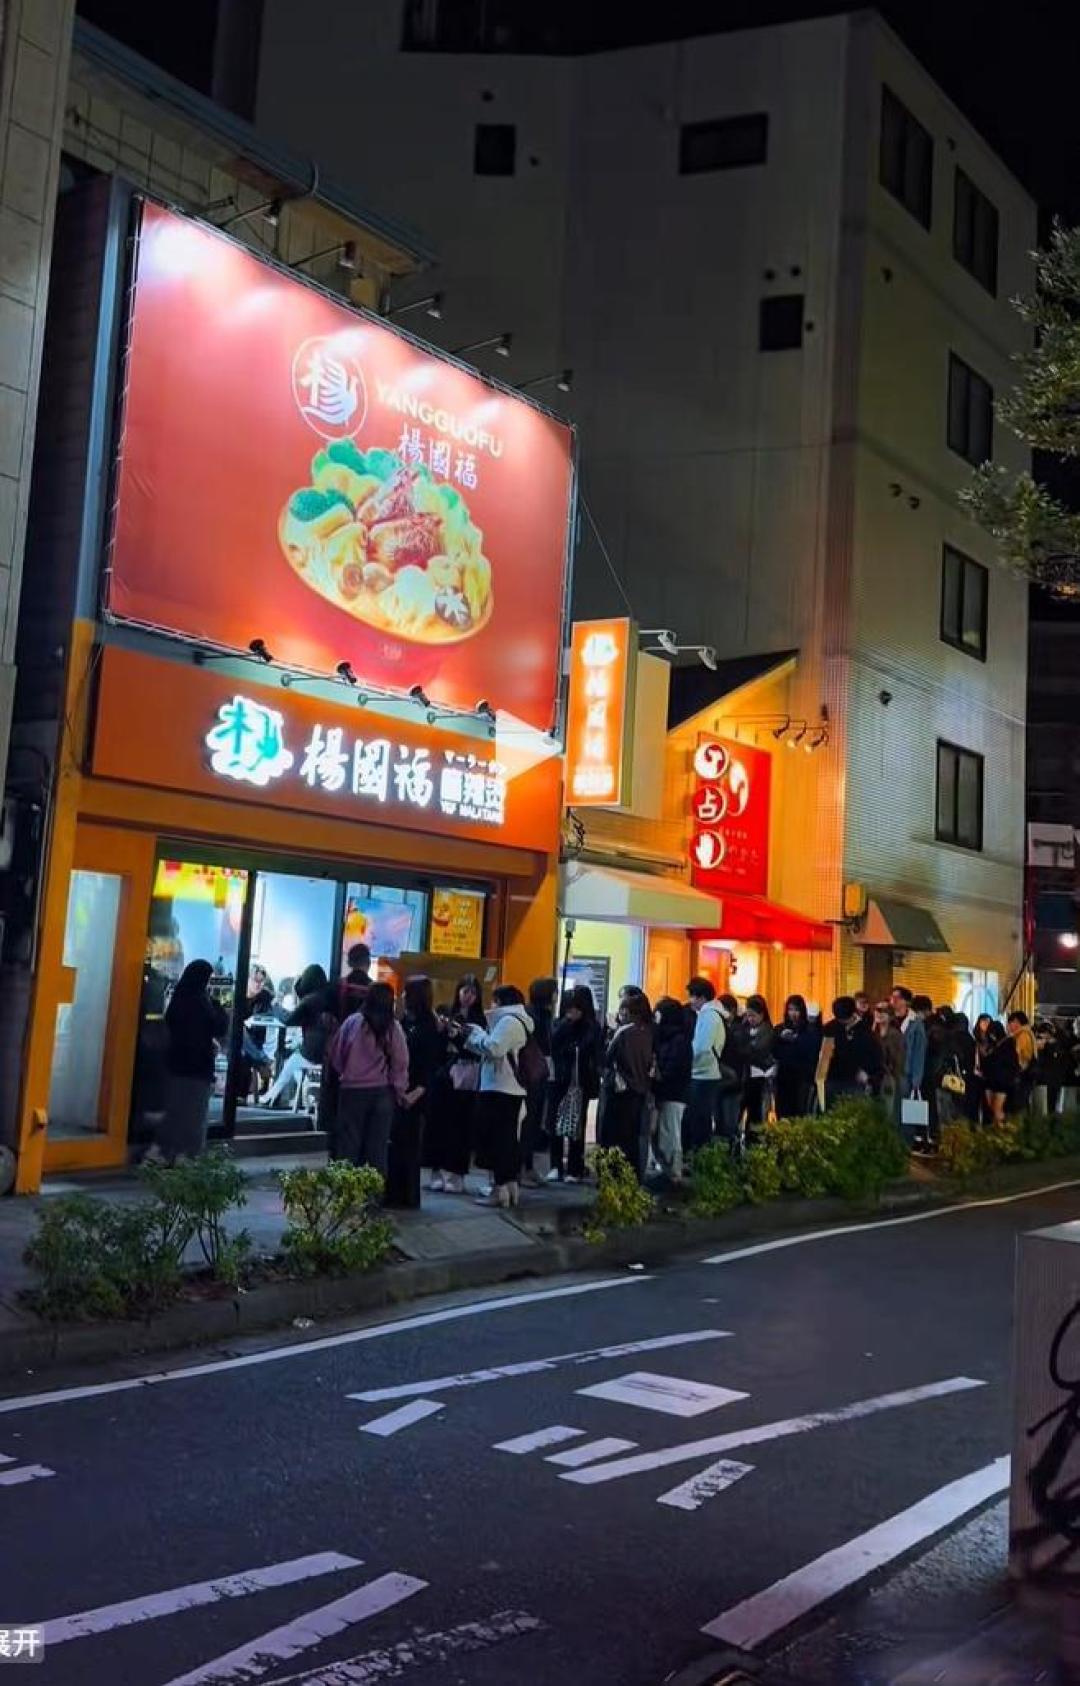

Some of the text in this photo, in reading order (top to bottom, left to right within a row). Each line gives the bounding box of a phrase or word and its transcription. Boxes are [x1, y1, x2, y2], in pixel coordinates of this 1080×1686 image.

[376, 377, 503, 458] YANGGUOFU
[397, 422, 478, 490] 楊國福
[299, 724, 434, 807] 楊國福
[697, 787, 719, 818] 占
